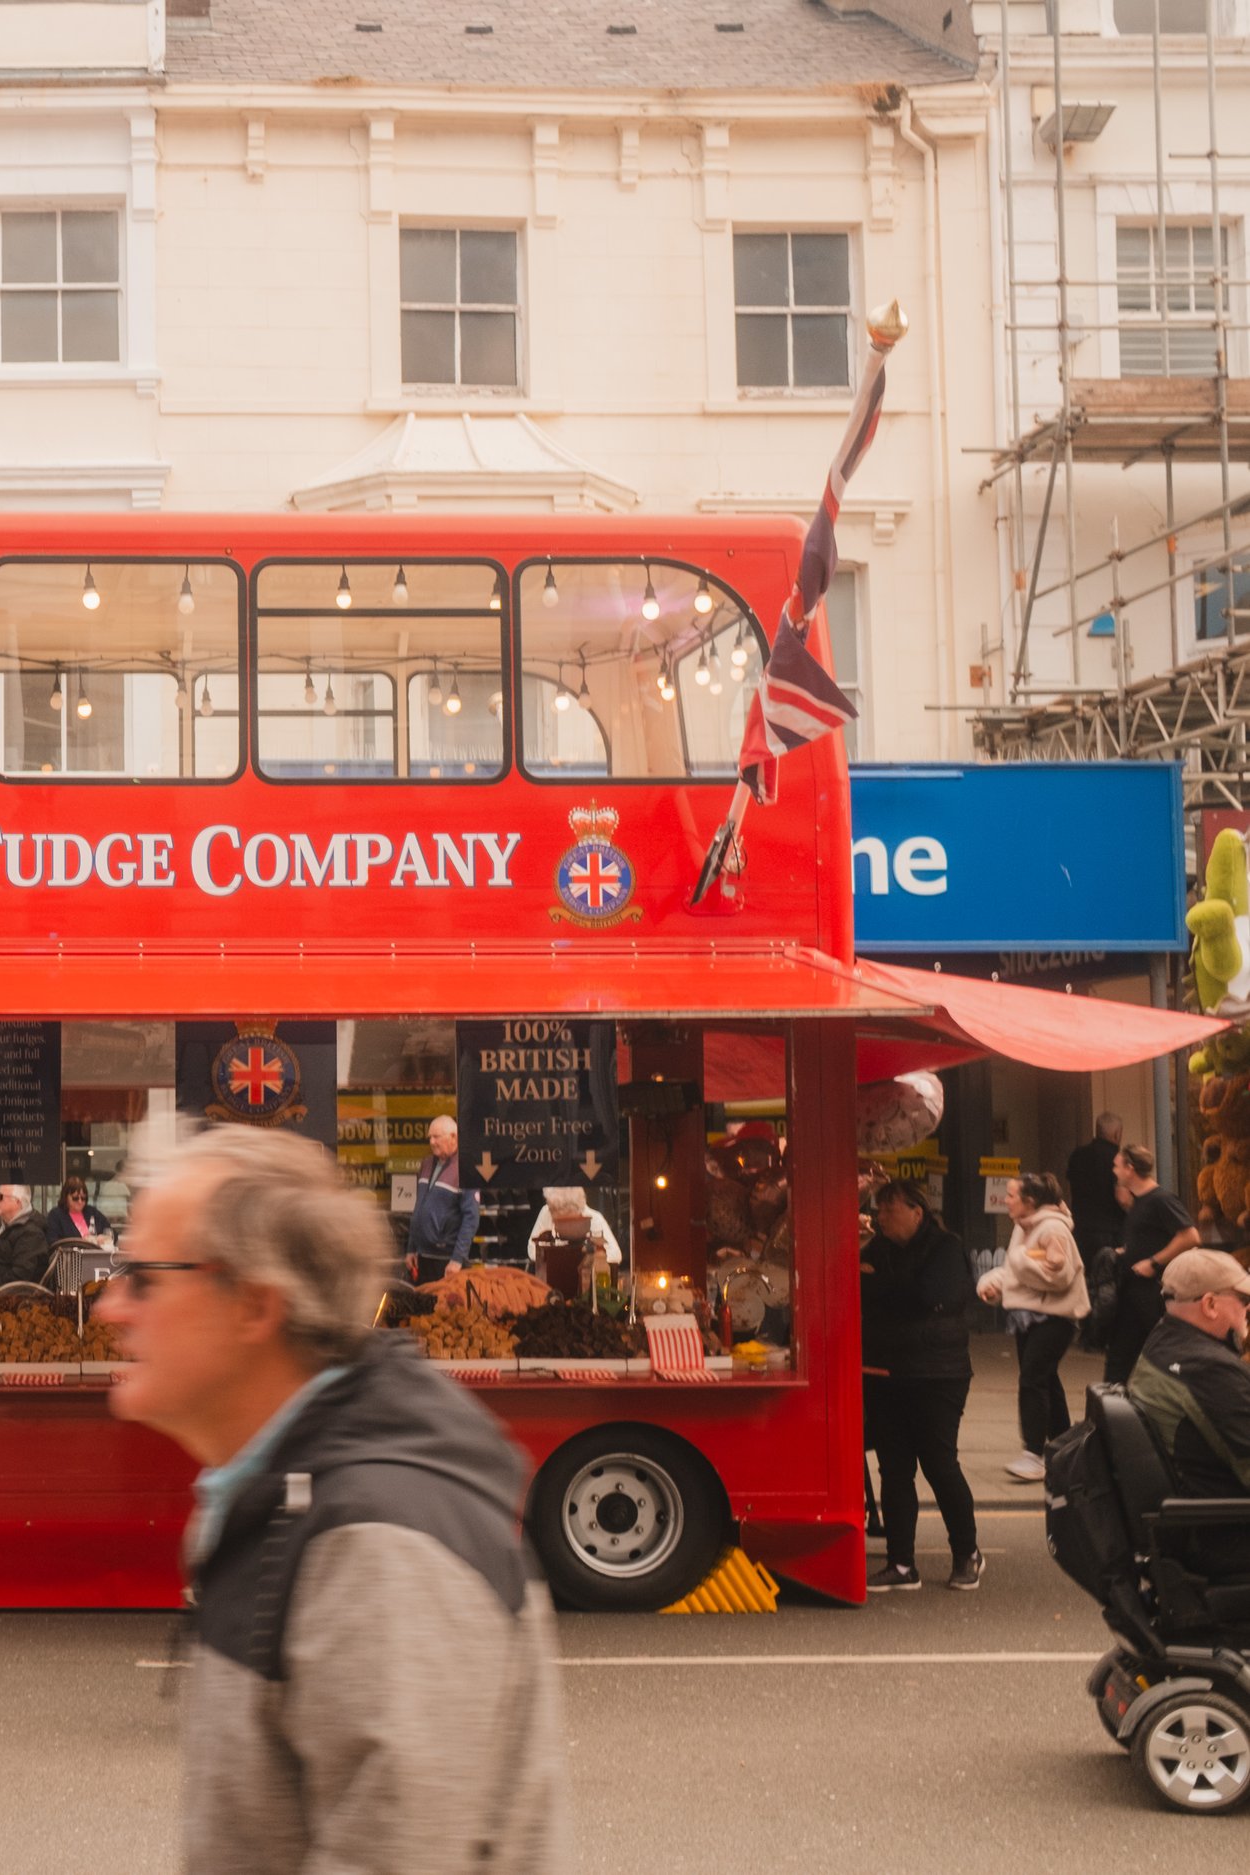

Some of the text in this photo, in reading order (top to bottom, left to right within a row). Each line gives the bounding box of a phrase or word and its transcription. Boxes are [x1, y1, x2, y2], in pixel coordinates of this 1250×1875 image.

[191, 824, 521, 896] COMPANY
[851, 836, 948, 896] ne
[502, 1020, 572, 1043] 100%
[4, 1048, 22, 1059] and
[24, 1048, 40, 1059] full
[479, 1048, 592, 1072] BRITISH
[12, 1063, 33, 1074] milk
[495, 1077, 578, 1101] MADE
[3, 1111, 45, 1123] products
[0, 1127, 23, 1137] taste
[25, 1126, 43, 1137] and
[483, 1116, 593, 1141] Finger Free
[14, 1142, 23, 1152] in
[25, 1142, 41, 1152] the
[514, 1144, 563, 1163] Zone
[1, 1157, 26, 1168] trade
